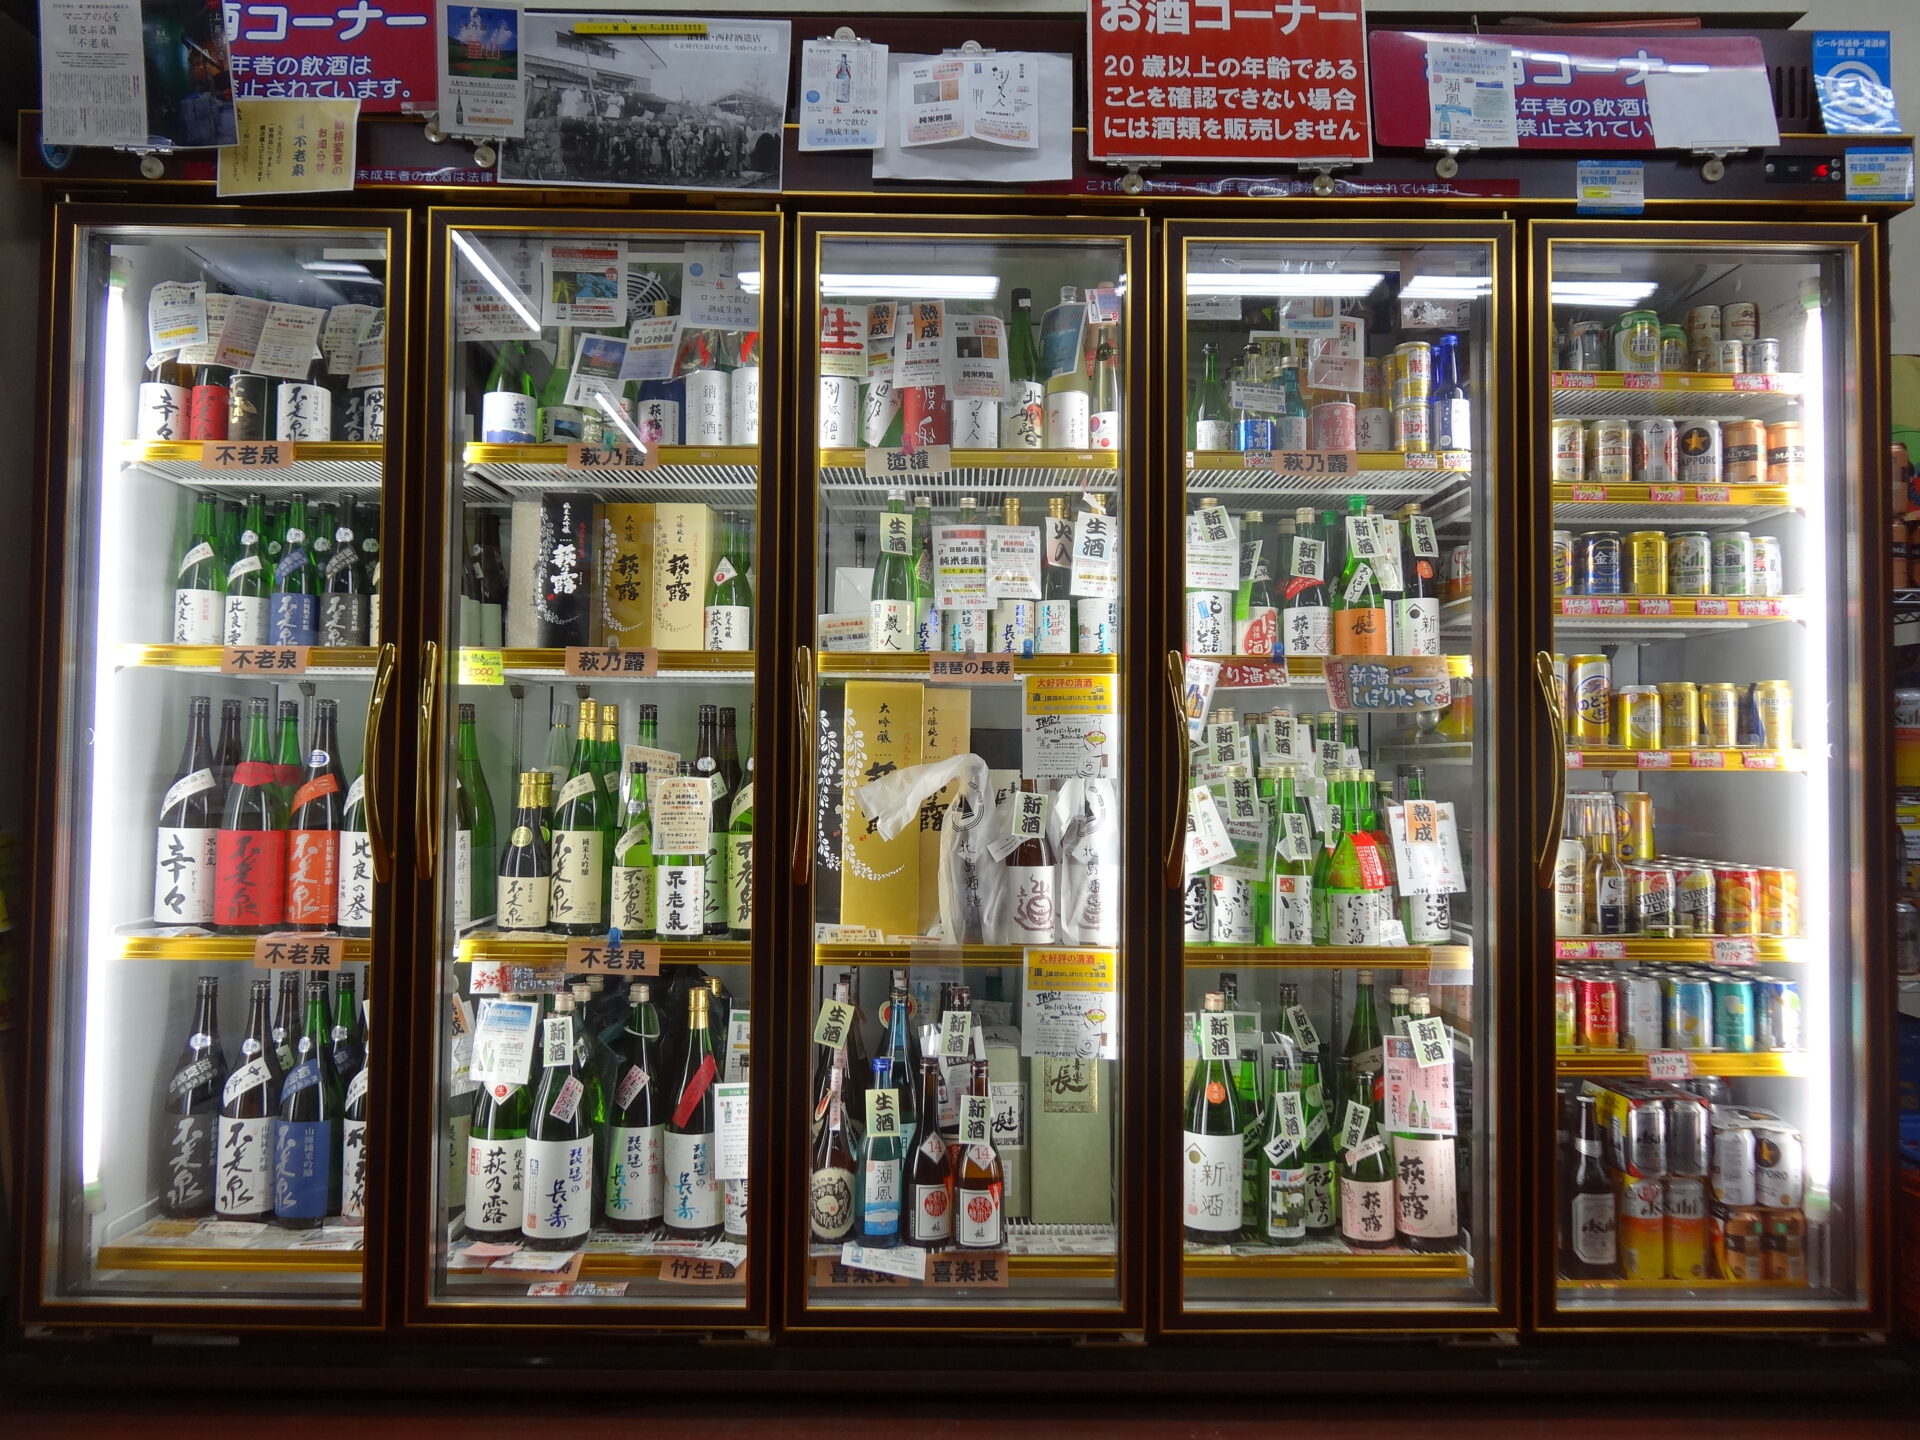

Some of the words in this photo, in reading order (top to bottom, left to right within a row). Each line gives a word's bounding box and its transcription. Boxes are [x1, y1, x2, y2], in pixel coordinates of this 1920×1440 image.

[62, 12, 121, 23] マニアの心を
[1101, 0, 1357, 35] お酒コーナー
[1104, 86, 1357, 111] ことを確認できない場合
[817, 118, 869, 127] ロックで飲む
[1104, 117, 1361, 142] には酒類を販売しません
[357, 169, 500, 185] 未成年者の飲酒は法律
[700, 294, 750, 305] ロックで飲む
[870, 304, 891, 336] 熟成
[919, 303, 941, 339] 熟成
[215, 445, 280, 466] 不老泉
[580, 447, 646, 467] 萩乃露
[1283, 453, 1349, 473] 萩乃露
[888, 518, 907, 552] 生酒
[1082, 518, 1107, 558] 生酒
[1203, 509, 1227, 541] 新酒
[1353, 518, 1376, 555] 新酒
[1413, 518, 1434, 554] 新酒
[1298, 541, 1317, 575] 新酒
[1594, 551, 1618, 566] 金麦
[231, 650, 297, 669] 不老泉
[578, 651, 645, 672] 萩乃露
[932, 661, 1011, 676] 琵琶の長寿
[1350, 663, 1390, 686] 新酒
[1037, 678, 1093, 689] 大好評の清酒
[1352, 687, 1431, 708] しぼりたて
[877, 702, 892, 744] 大吟醸
[1274, 718, 1292, 754] 新酒
[1216, 725, 1235, 762] 新酒
[1322, 742, 1340, 777] 新酒
[1022, 795, 1042, 834] 新酒
[1233, 779, 1254, 818] 新酒
[1288, 815, 1308, 855] 新酒
[1413, 803, 1433, 842] 熟成
[623, 869, 644, 926] 不老泉
[665, 870, 687, 931] 不老泉
[265, 943, 331, 965] 不老泉
[580, 949, 646, 970] 不老泉
[1039, 953, 1095, 965] 大好評の清酒
[823, 1004, 846, 1044] 生酒
[947, 1014, 966, 1054] 新酒
[1210, 1016, 1230, 1057] 新酒
[1291, 1009, 1316, 1046] 新酒
[1419, 1020, 1445, 1062] 新酒
[550, 1022, 567, 1061] 新酒
[875, 1092, 894, 1132] 生酒
[968, 1099, 987, 1141] 新酒
[1281, 1095, 1300, 1138] 新酒
[1346, 1105, 1365, 1149] 新酒
[927, 1140, 944, 1153] 14
[974, 1147, 991, 1161] 14
[482, 1148, 509, 1225] 萩乃露
[1200, 1160, 1225, 1218] 新酒
[670, 1262, 736, 1280] 竹生島
[931, 1259, 999, 1282] 喜楽長
